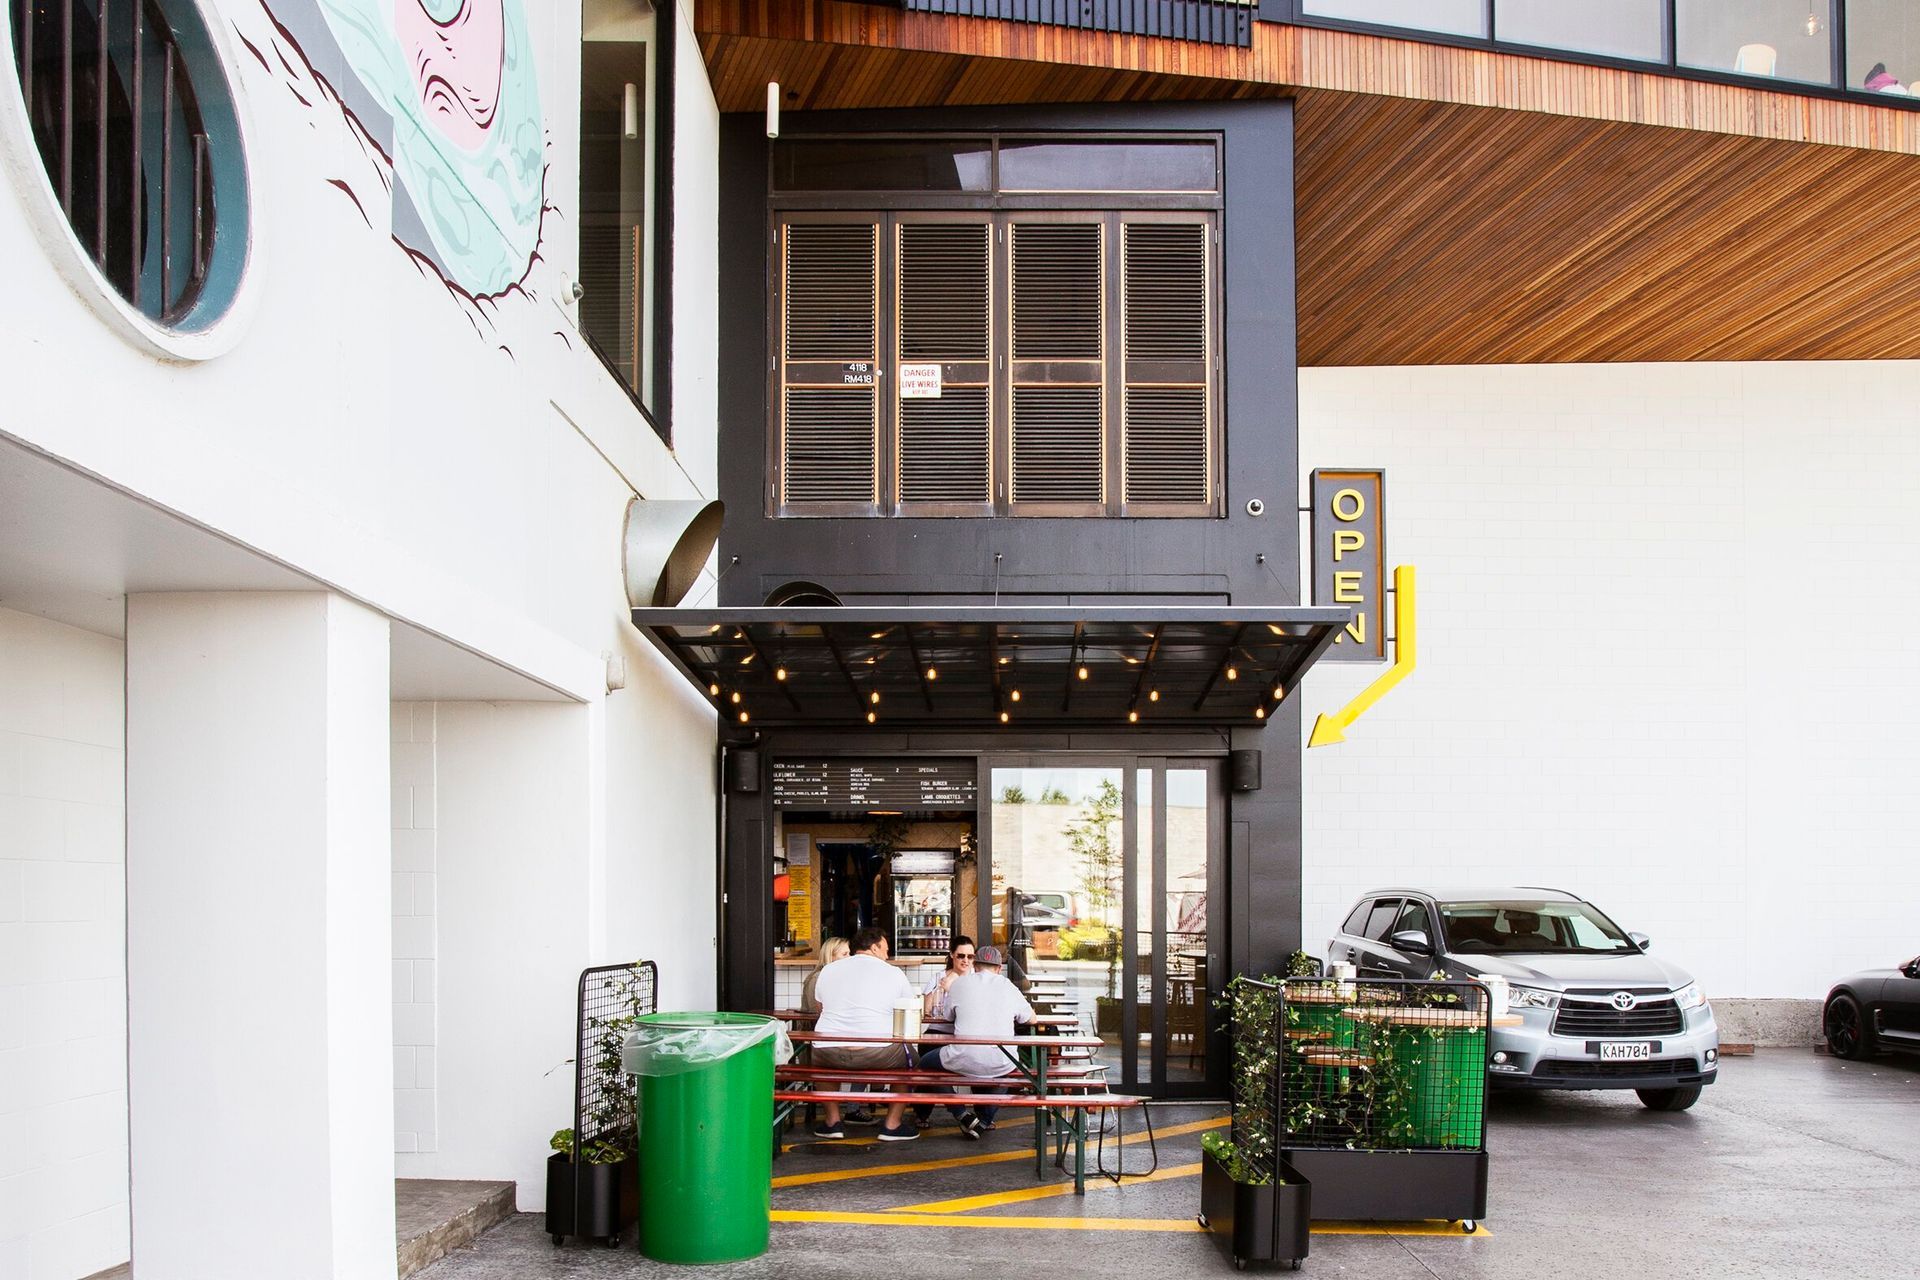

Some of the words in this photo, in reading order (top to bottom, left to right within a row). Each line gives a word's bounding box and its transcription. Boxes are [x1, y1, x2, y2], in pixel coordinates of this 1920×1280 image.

[849, 364, 868, 372] 4118
[844, 375, 872, 383] RM418
[1332, 488, 1366, 644] OPEN
[1603, 1046, 1648, 1058] KAH704
